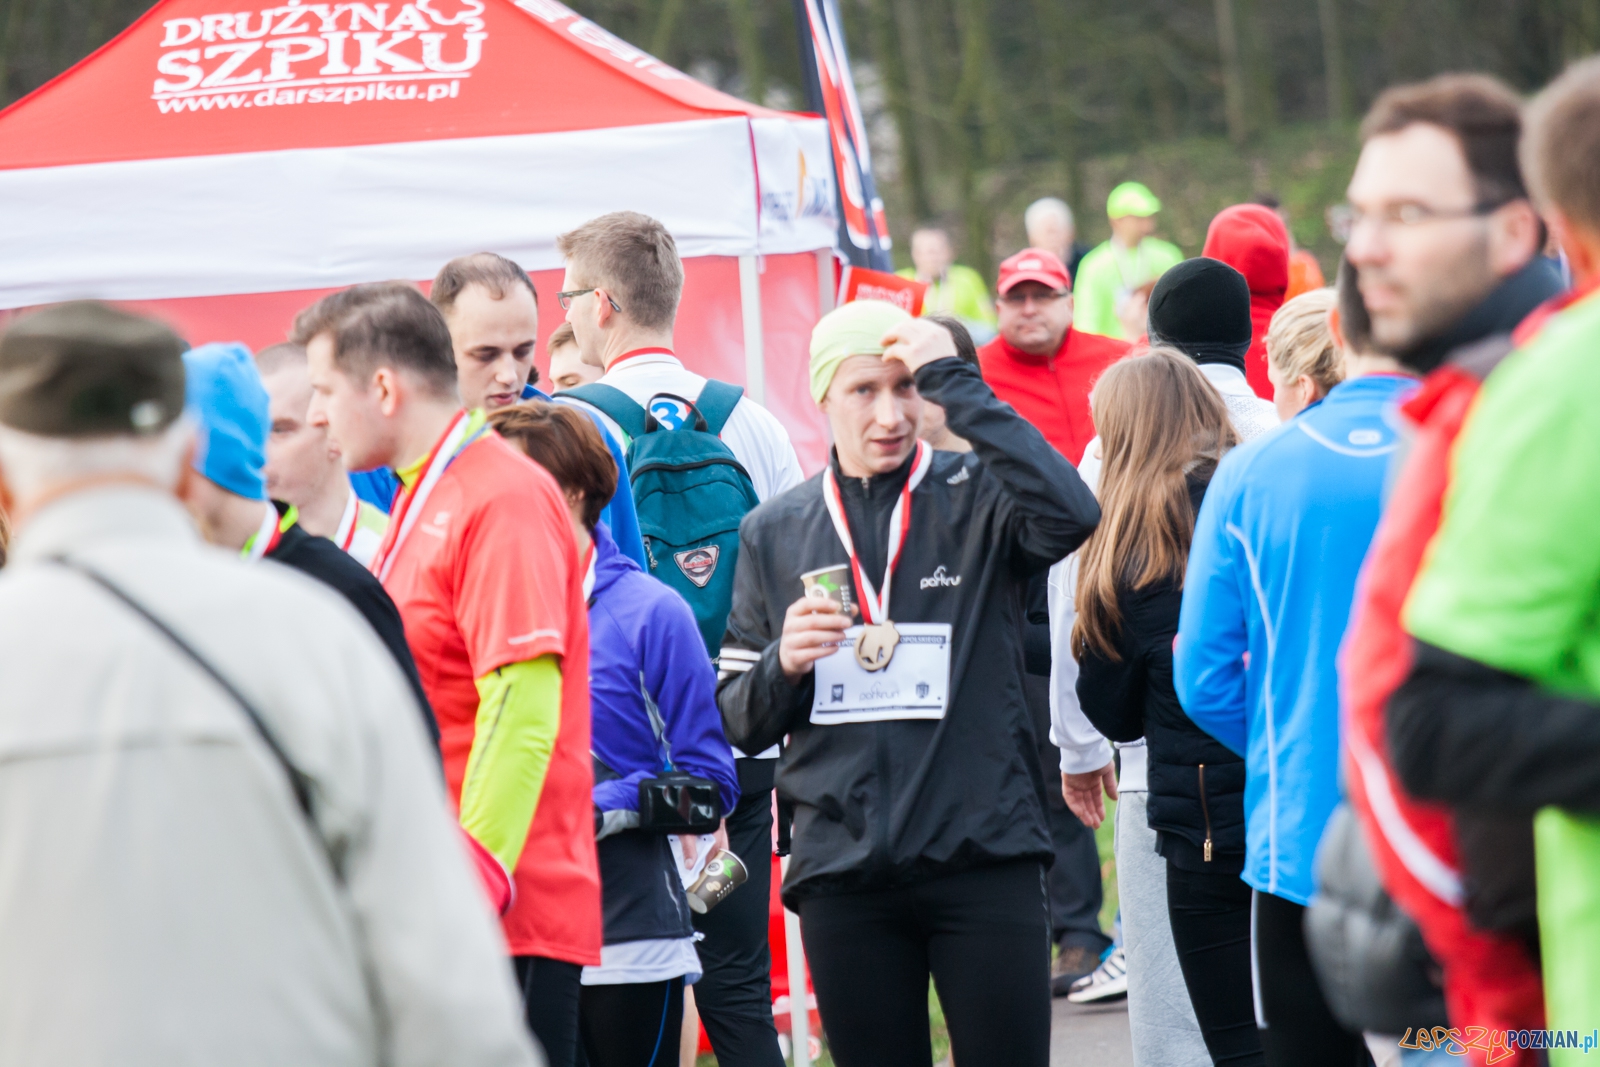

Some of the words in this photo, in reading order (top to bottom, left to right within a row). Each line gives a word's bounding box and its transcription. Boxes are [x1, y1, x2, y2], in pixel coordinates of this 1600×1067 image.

[160, 0, 431, 47] DRUŻYNA
[153, 31, 488, 94] SZPIKU
[156, 80, 460, 114] www.darszpiku.pl
[920, 566, 961, 590] parkru
[900, 635, 942, 643] OPOLSKIEGO
